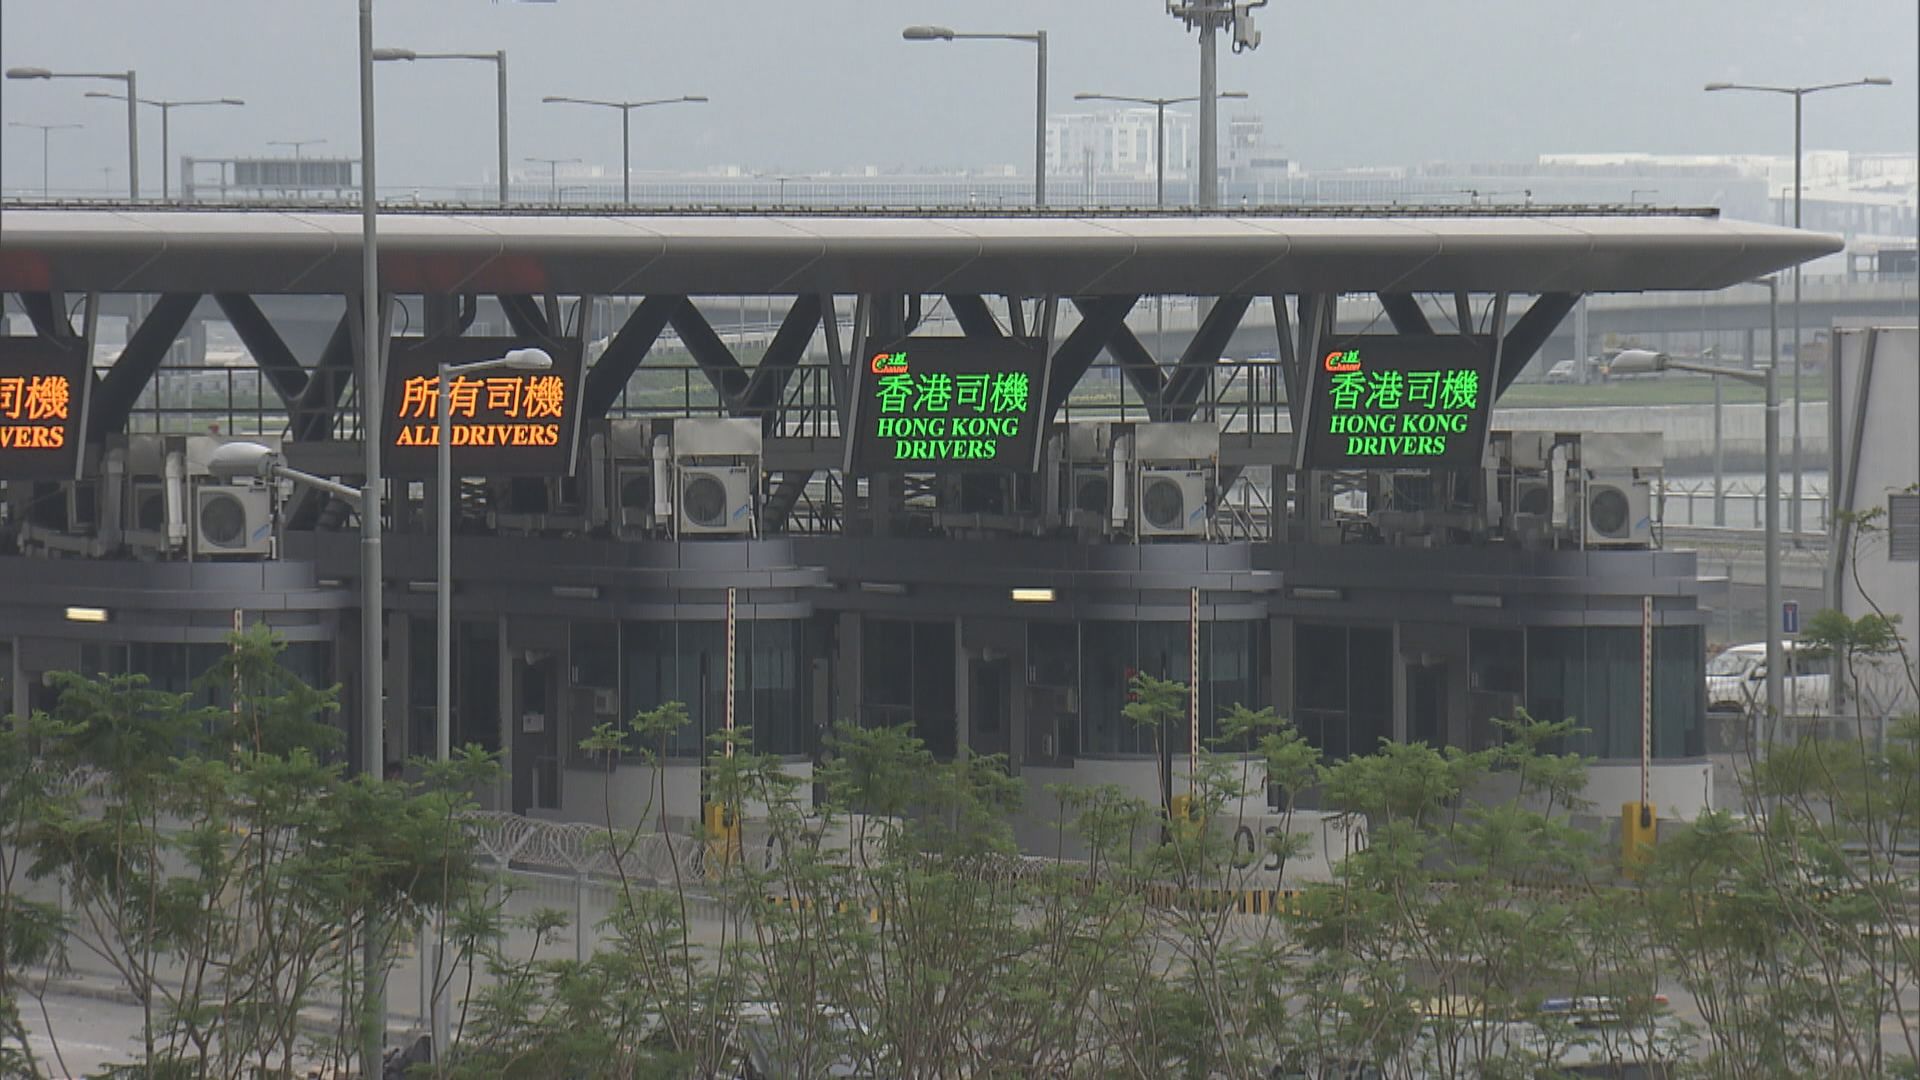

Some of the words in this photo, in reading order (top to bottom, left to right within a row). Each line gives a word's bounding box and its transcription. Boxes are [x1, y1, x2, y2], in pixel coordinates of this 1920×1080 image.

[399, 375, 564, 418] 所有司機
[876, 372, 1030, 414] 香港司機
[1329, 370, 1479, 410] 香港司機
[877, 418, 945, 437] HONG
[951, 418, 1019, 437] KONG
[1329, 414, 1396, 433] HONG
[1402, 414, 1468, 433] KONG
[451, 424, 559, 446] DRIVERS
[1346, 435, 1446, 456] DRIVERS
[895, 439, 997, 460] DRIVERS
